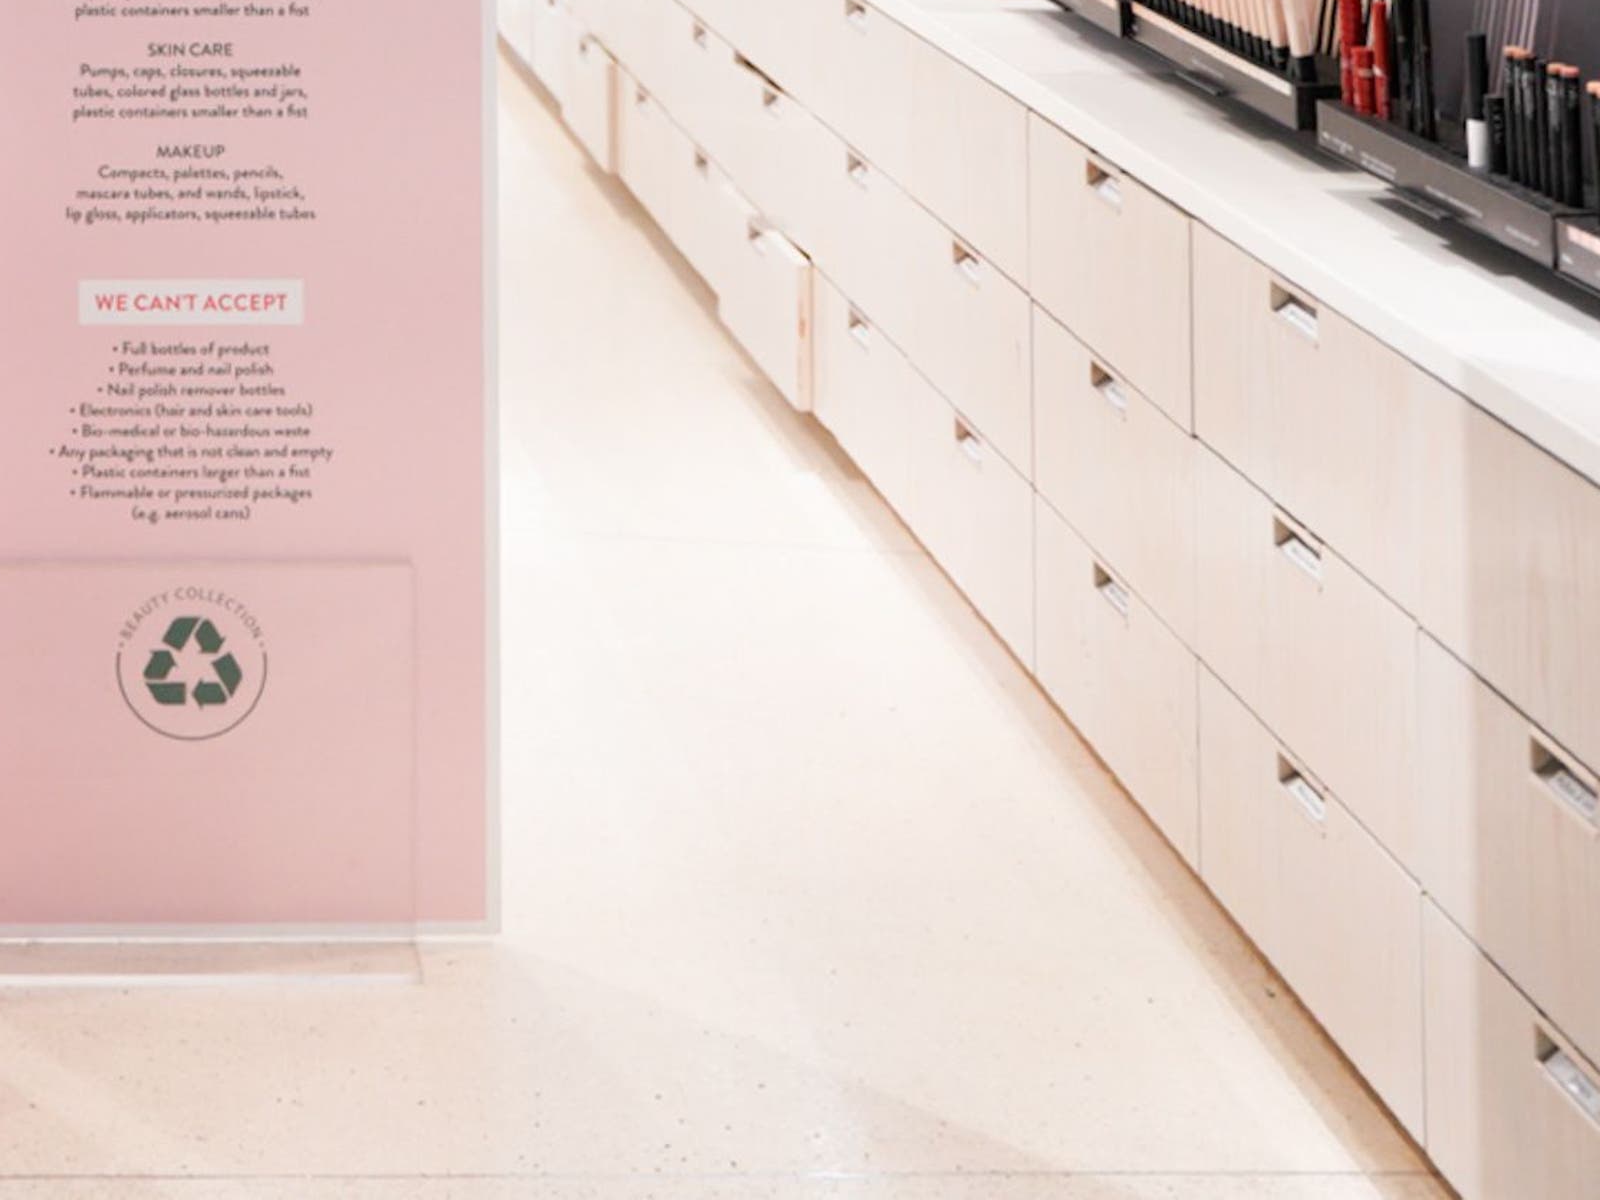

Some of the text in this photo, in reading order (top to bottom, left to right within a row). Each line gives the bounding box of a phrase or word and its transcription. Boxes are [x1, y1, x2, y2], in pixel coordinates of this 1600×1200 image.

[75, 2, 309, 21] plastic containers smaller than a fist
[148, 43, 232, 57] SKIN CARE
[230, 64, 301, 80] squeezable
[117, 84, 166, 97] colored
[169, 85, 200, 102] glass
[204, 85, 249, 97] bottles
[254, 85, 277, 97] and
[73, 104, 307, 122] plastic containers smaller than a fist
[156, 144, 225, 158] MAKEUP
[76, 190, 130, 200] mascara
[178, 187, 202, 199] and
[66, 207, 82, 223] lip
[205, 207, 276, 222] squeezable
[279, 207, 316, 219] tubes
[95, 294, 287, 312] WE CAN'T ACCEPT
[122, 341, 269, 358] Full bottles of product
[118, 362, 273, 379] Perfume and nail polish
[107, 383, 285, 400] Nail polish remover bottles
[79, 402, 312, 418] Electronics (hair and skin care tools)
[82, 423, 310, 437] Bio-medical or bio-hazardous waste
[58, 445, 333, 463] Any packaging that is not clean and empty
[82, 464, 309, 483] Plastic containers larger than a fist
[80, 485, 312, 503] Flammable or pressurized packages
[165, 506, 212, 519] aerosol
[215, 506, 250, 520] cans)
[119, 585, 261, 639] BEAUTY COLLECTION
